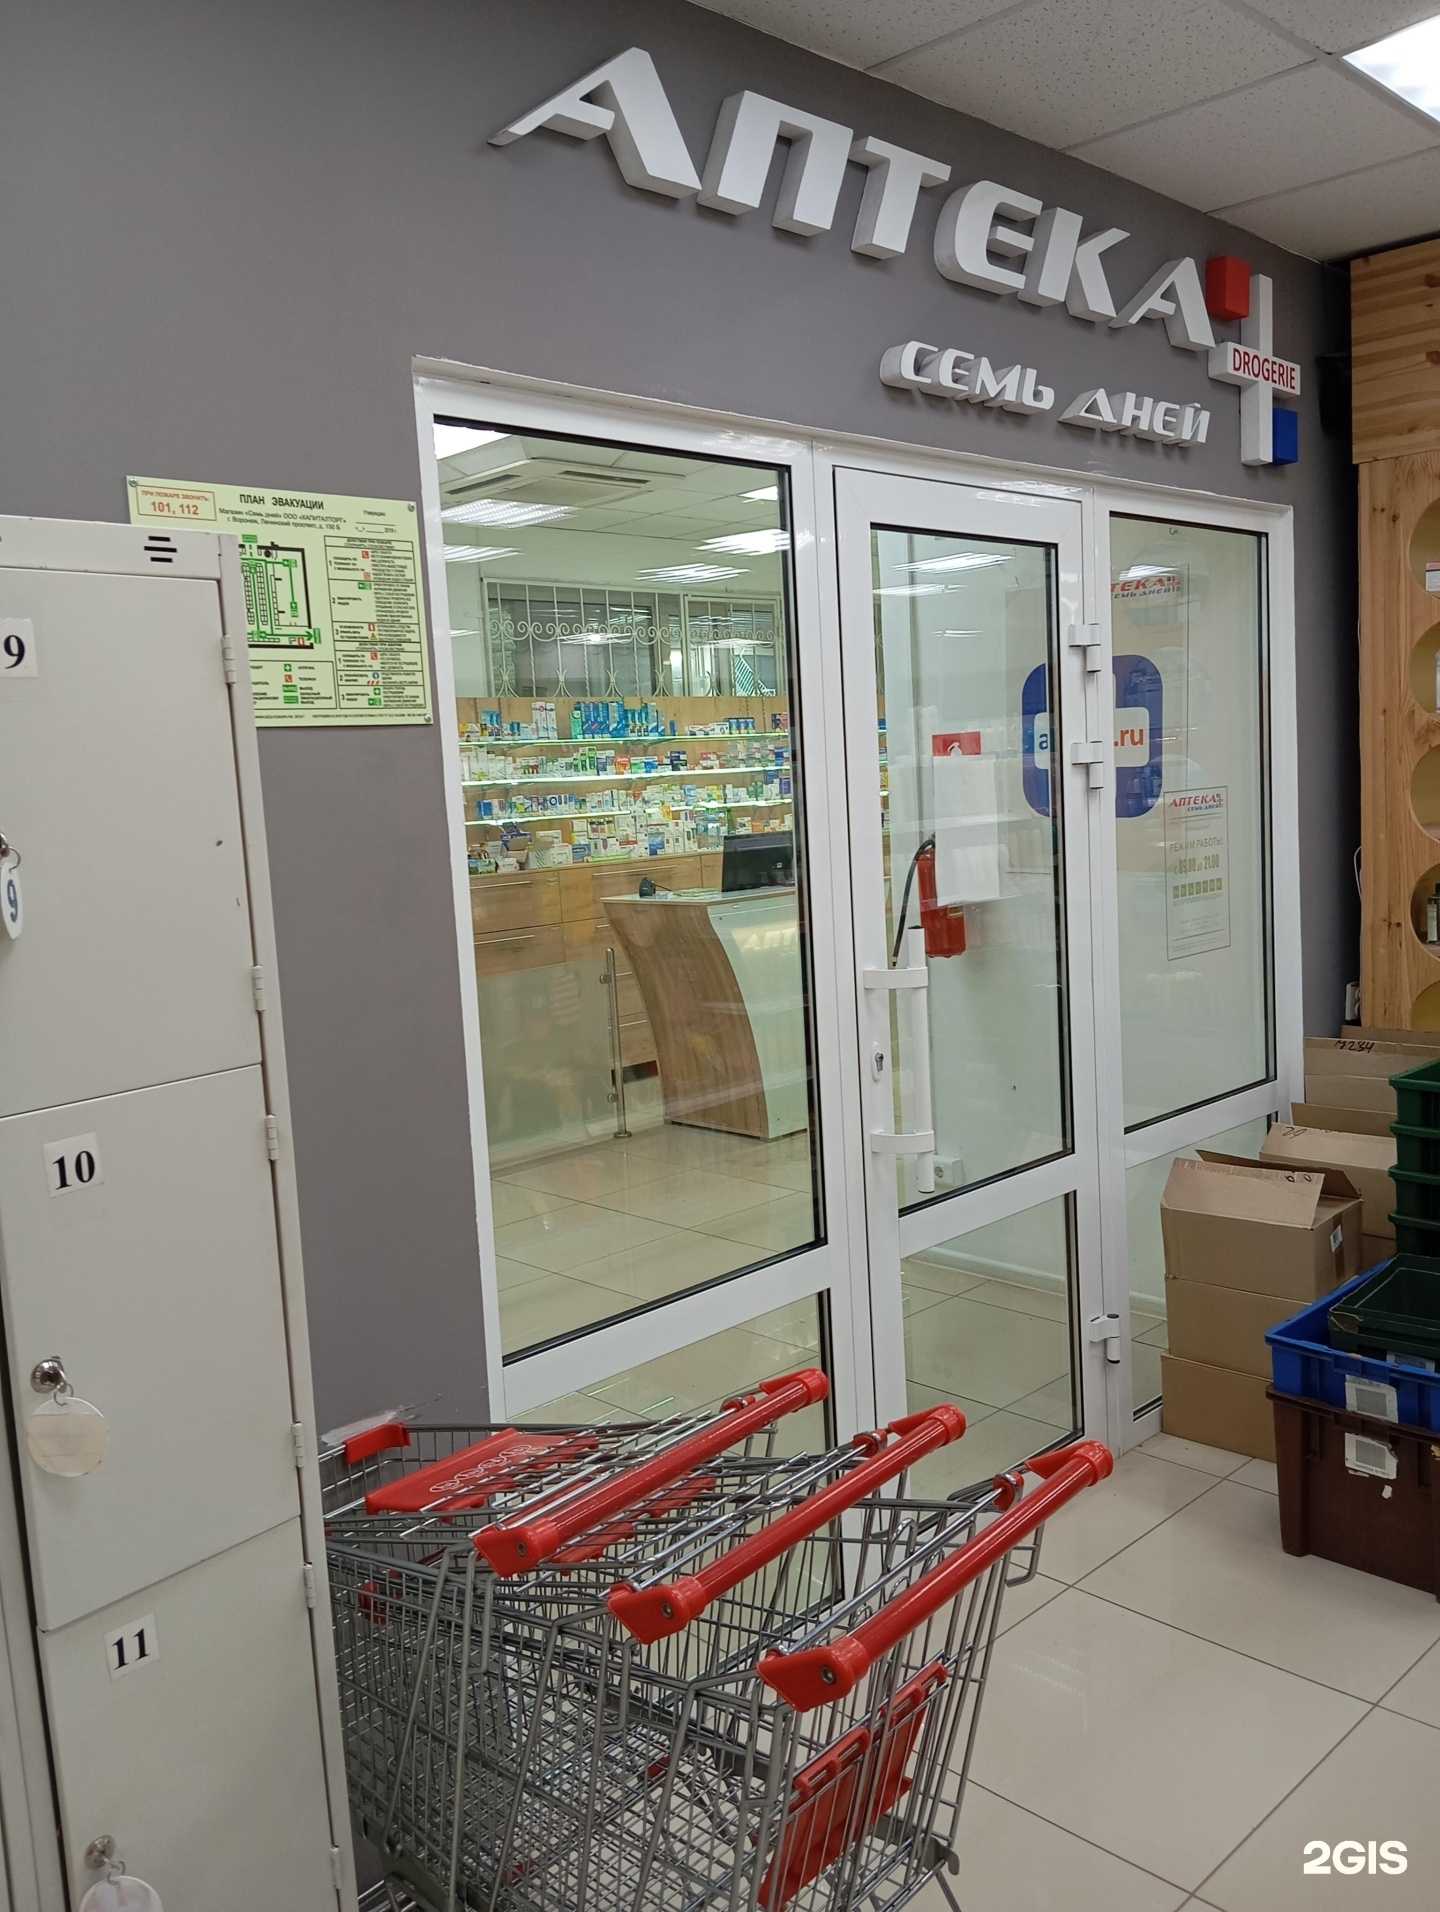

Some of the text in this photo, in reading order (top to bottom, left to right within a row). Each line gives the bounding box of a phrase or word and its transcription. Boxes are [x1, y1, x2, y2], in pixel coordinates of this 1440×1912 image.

[488, 46, 1216, 352] АПТЕКА
[1231, 346, 1298, 391] DROGERIE
[880, 339, 1212, 448] СЕМЬ ДНЕЙ
[180, 504, 200, 516] 112
[239, 494, 325, 511] ПЛАН ЭВАКУАЦИИ
[3, 634, 26, 670] 9
[1169, 792, 1217, 809] АПТЕКА
[6, 879, 18, 923] 9
[52, 1150, 96, 1191] 10
[111, 1627, 149, 1671] 11
